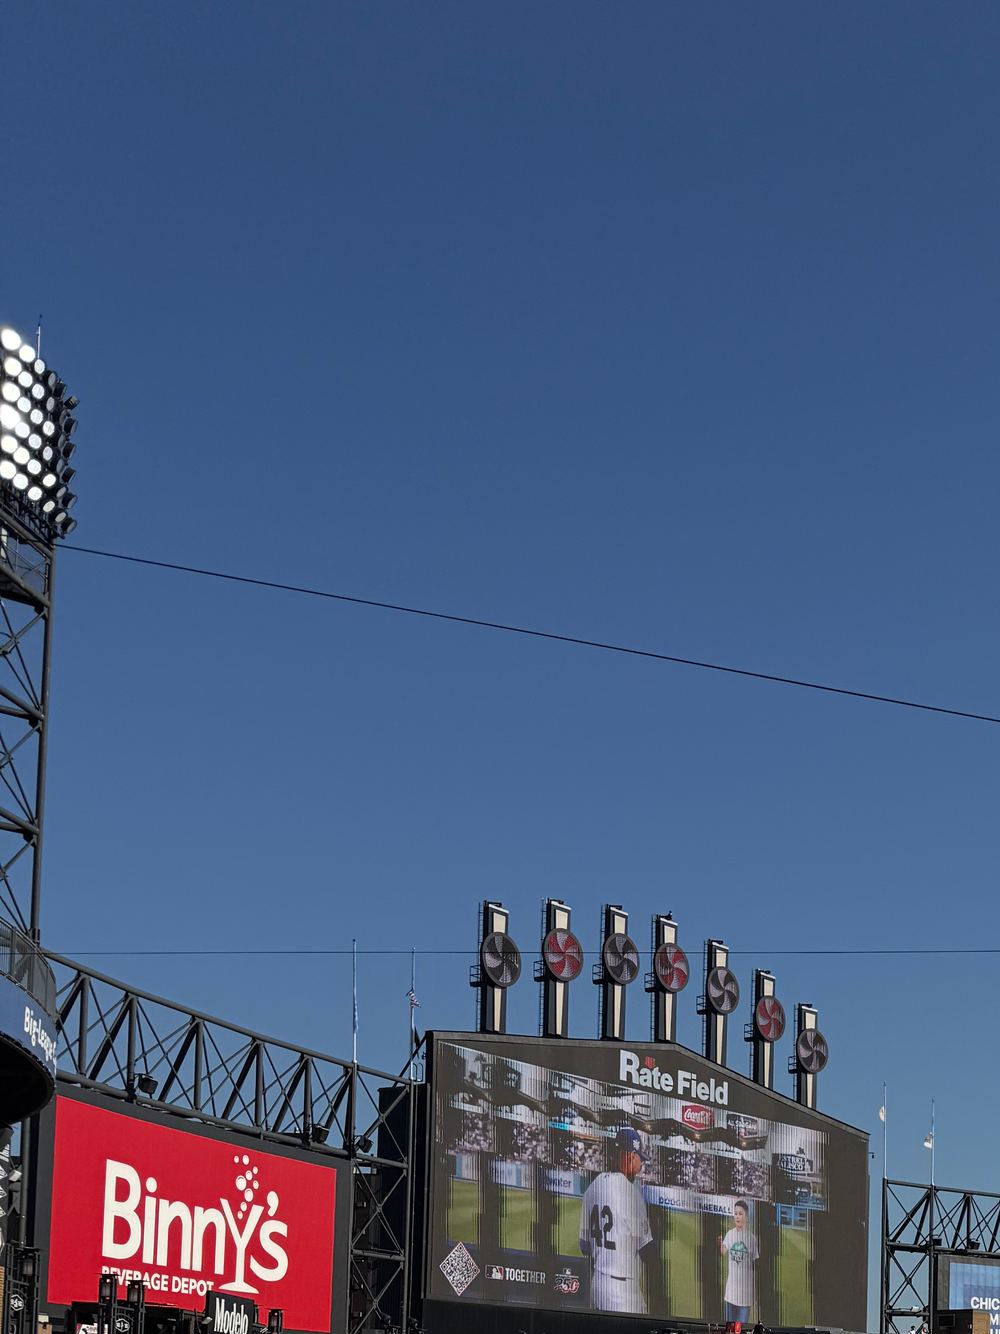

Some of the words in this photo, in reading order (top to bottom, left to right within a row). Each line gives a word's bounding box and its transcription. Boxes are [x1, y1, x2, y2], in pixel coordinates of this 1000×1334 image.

[619, 1049, 674, 1092] Rate
[677, 1070, 729, 1106] Field
[101, 1159, 289, 1294] Binny's
[590, 1204, 617, 1250] 42
[505, 1267, 546, 1284] TOGETHER
